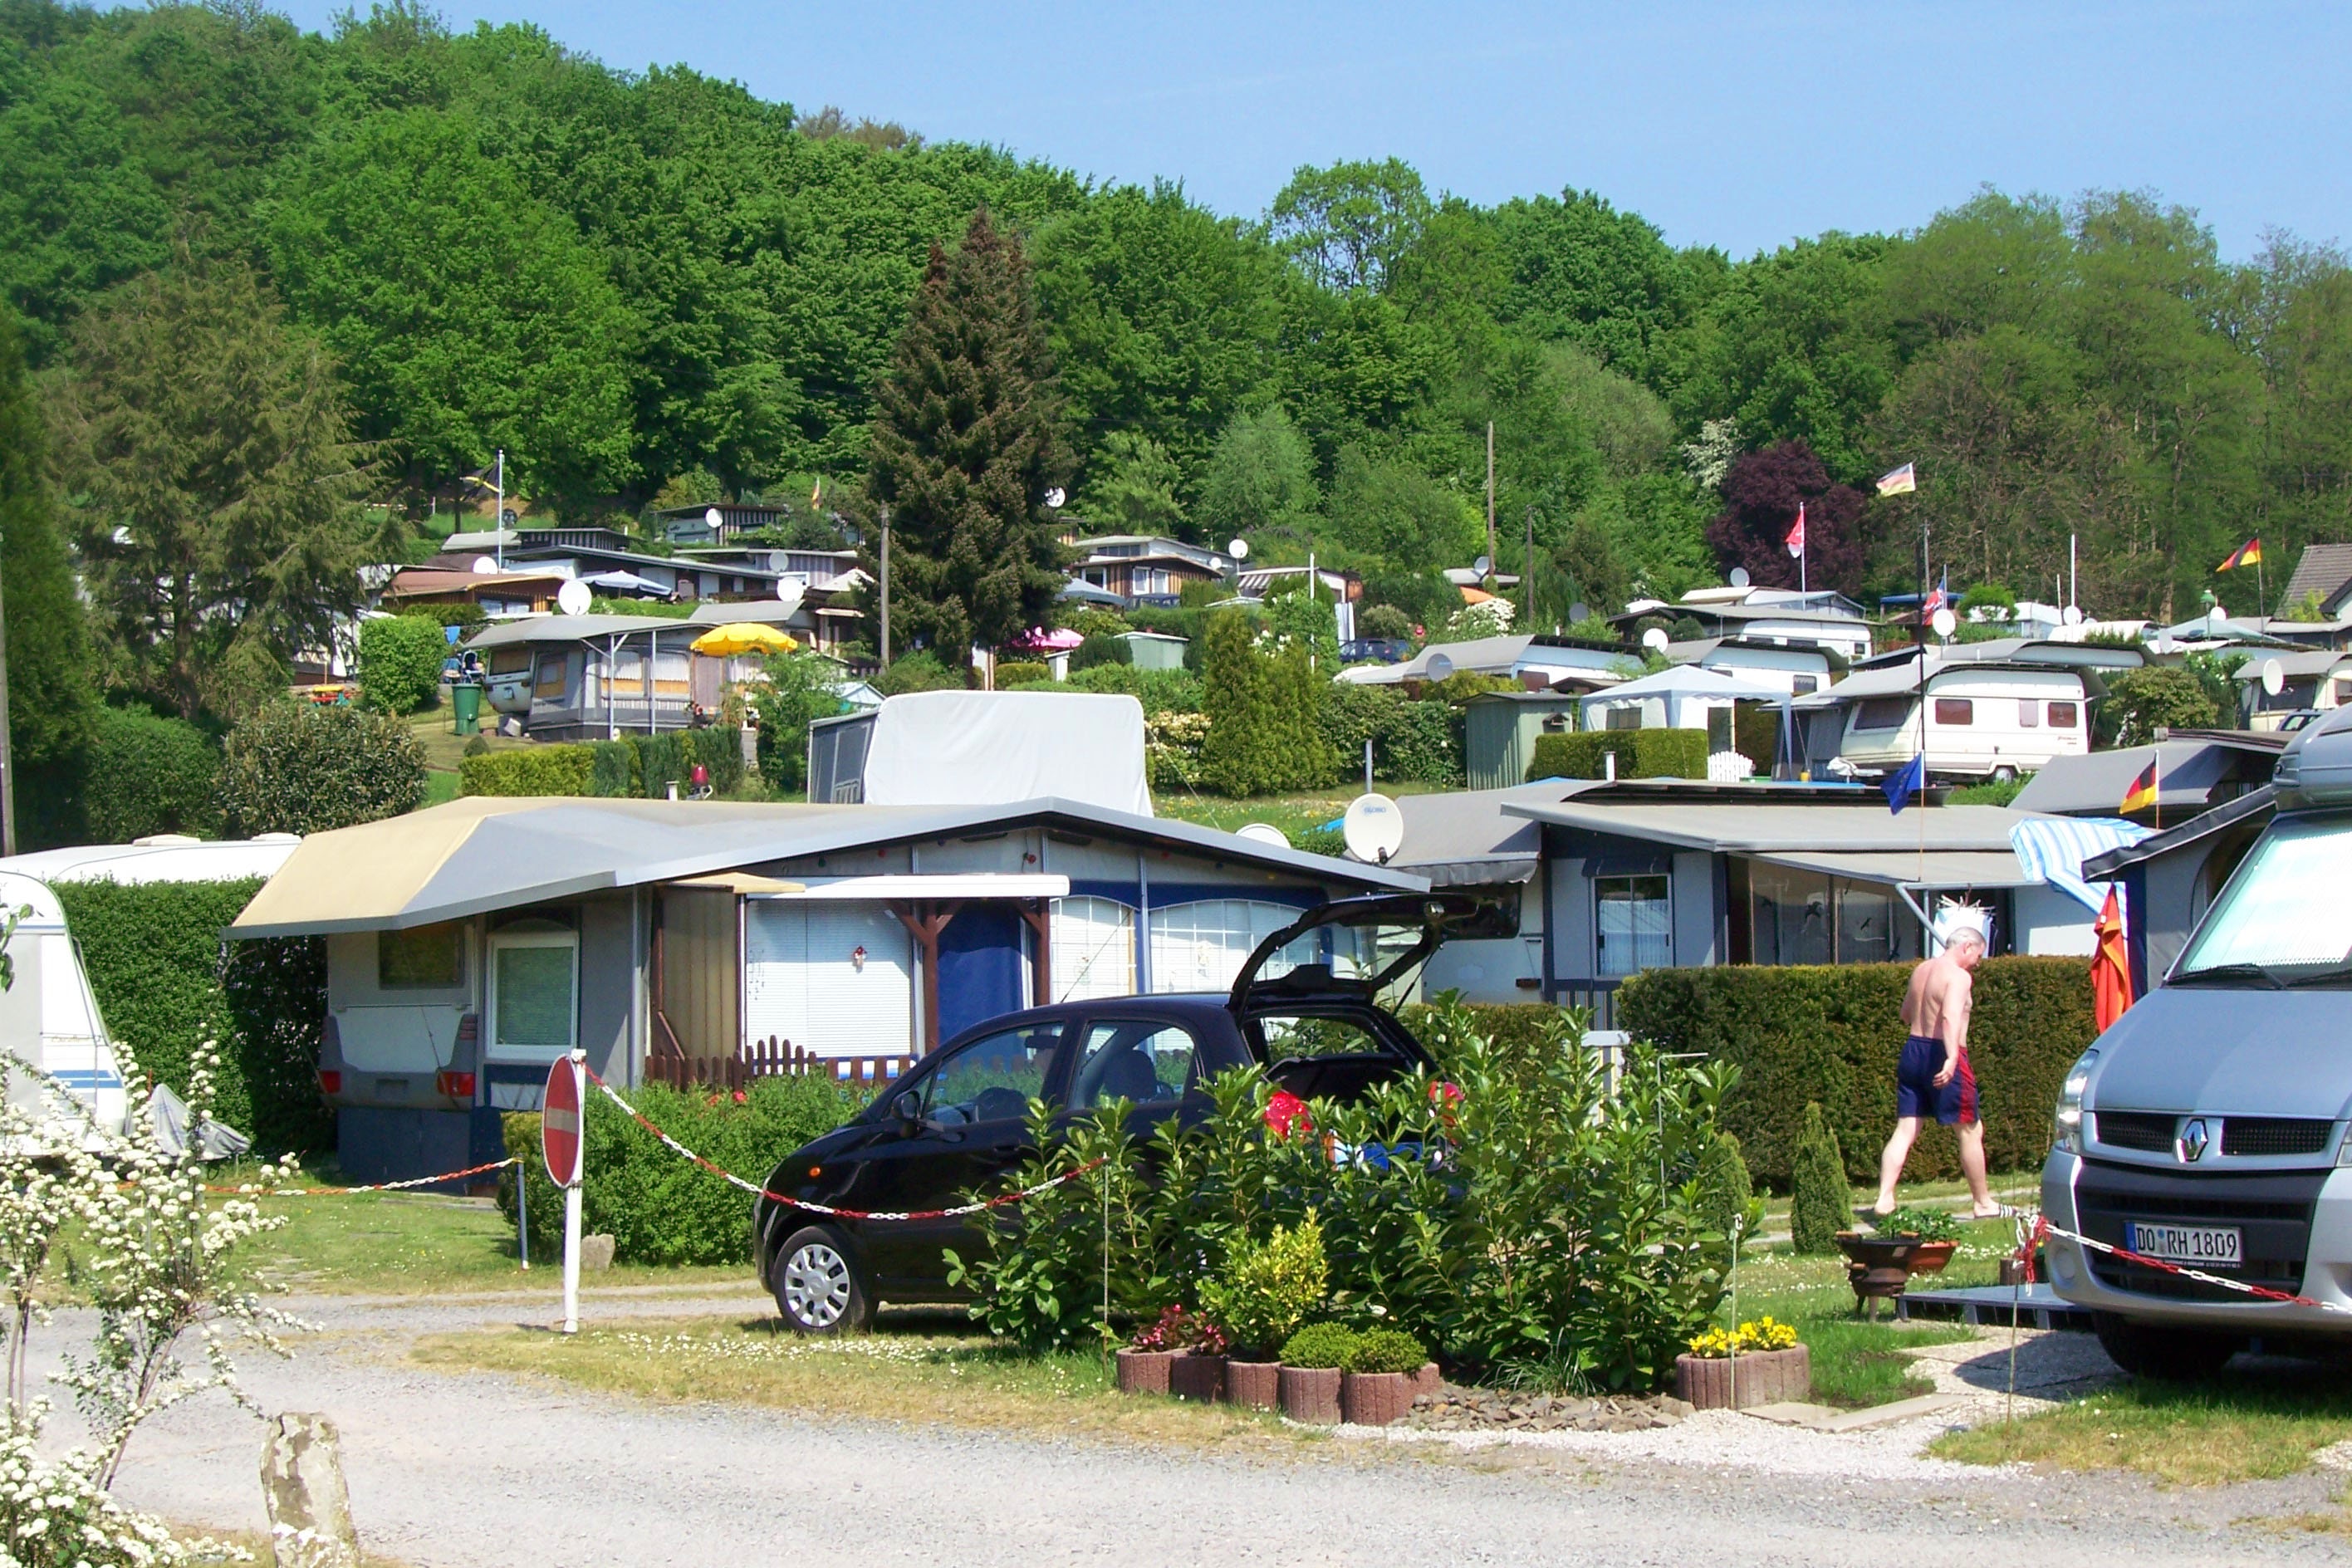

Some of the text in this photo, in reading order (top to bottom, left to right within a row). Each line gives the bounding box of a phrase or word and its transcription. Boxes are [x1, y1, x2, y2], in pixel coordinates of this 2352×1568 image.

[2136, 1227, 2237, 1257] DO RH 1809
